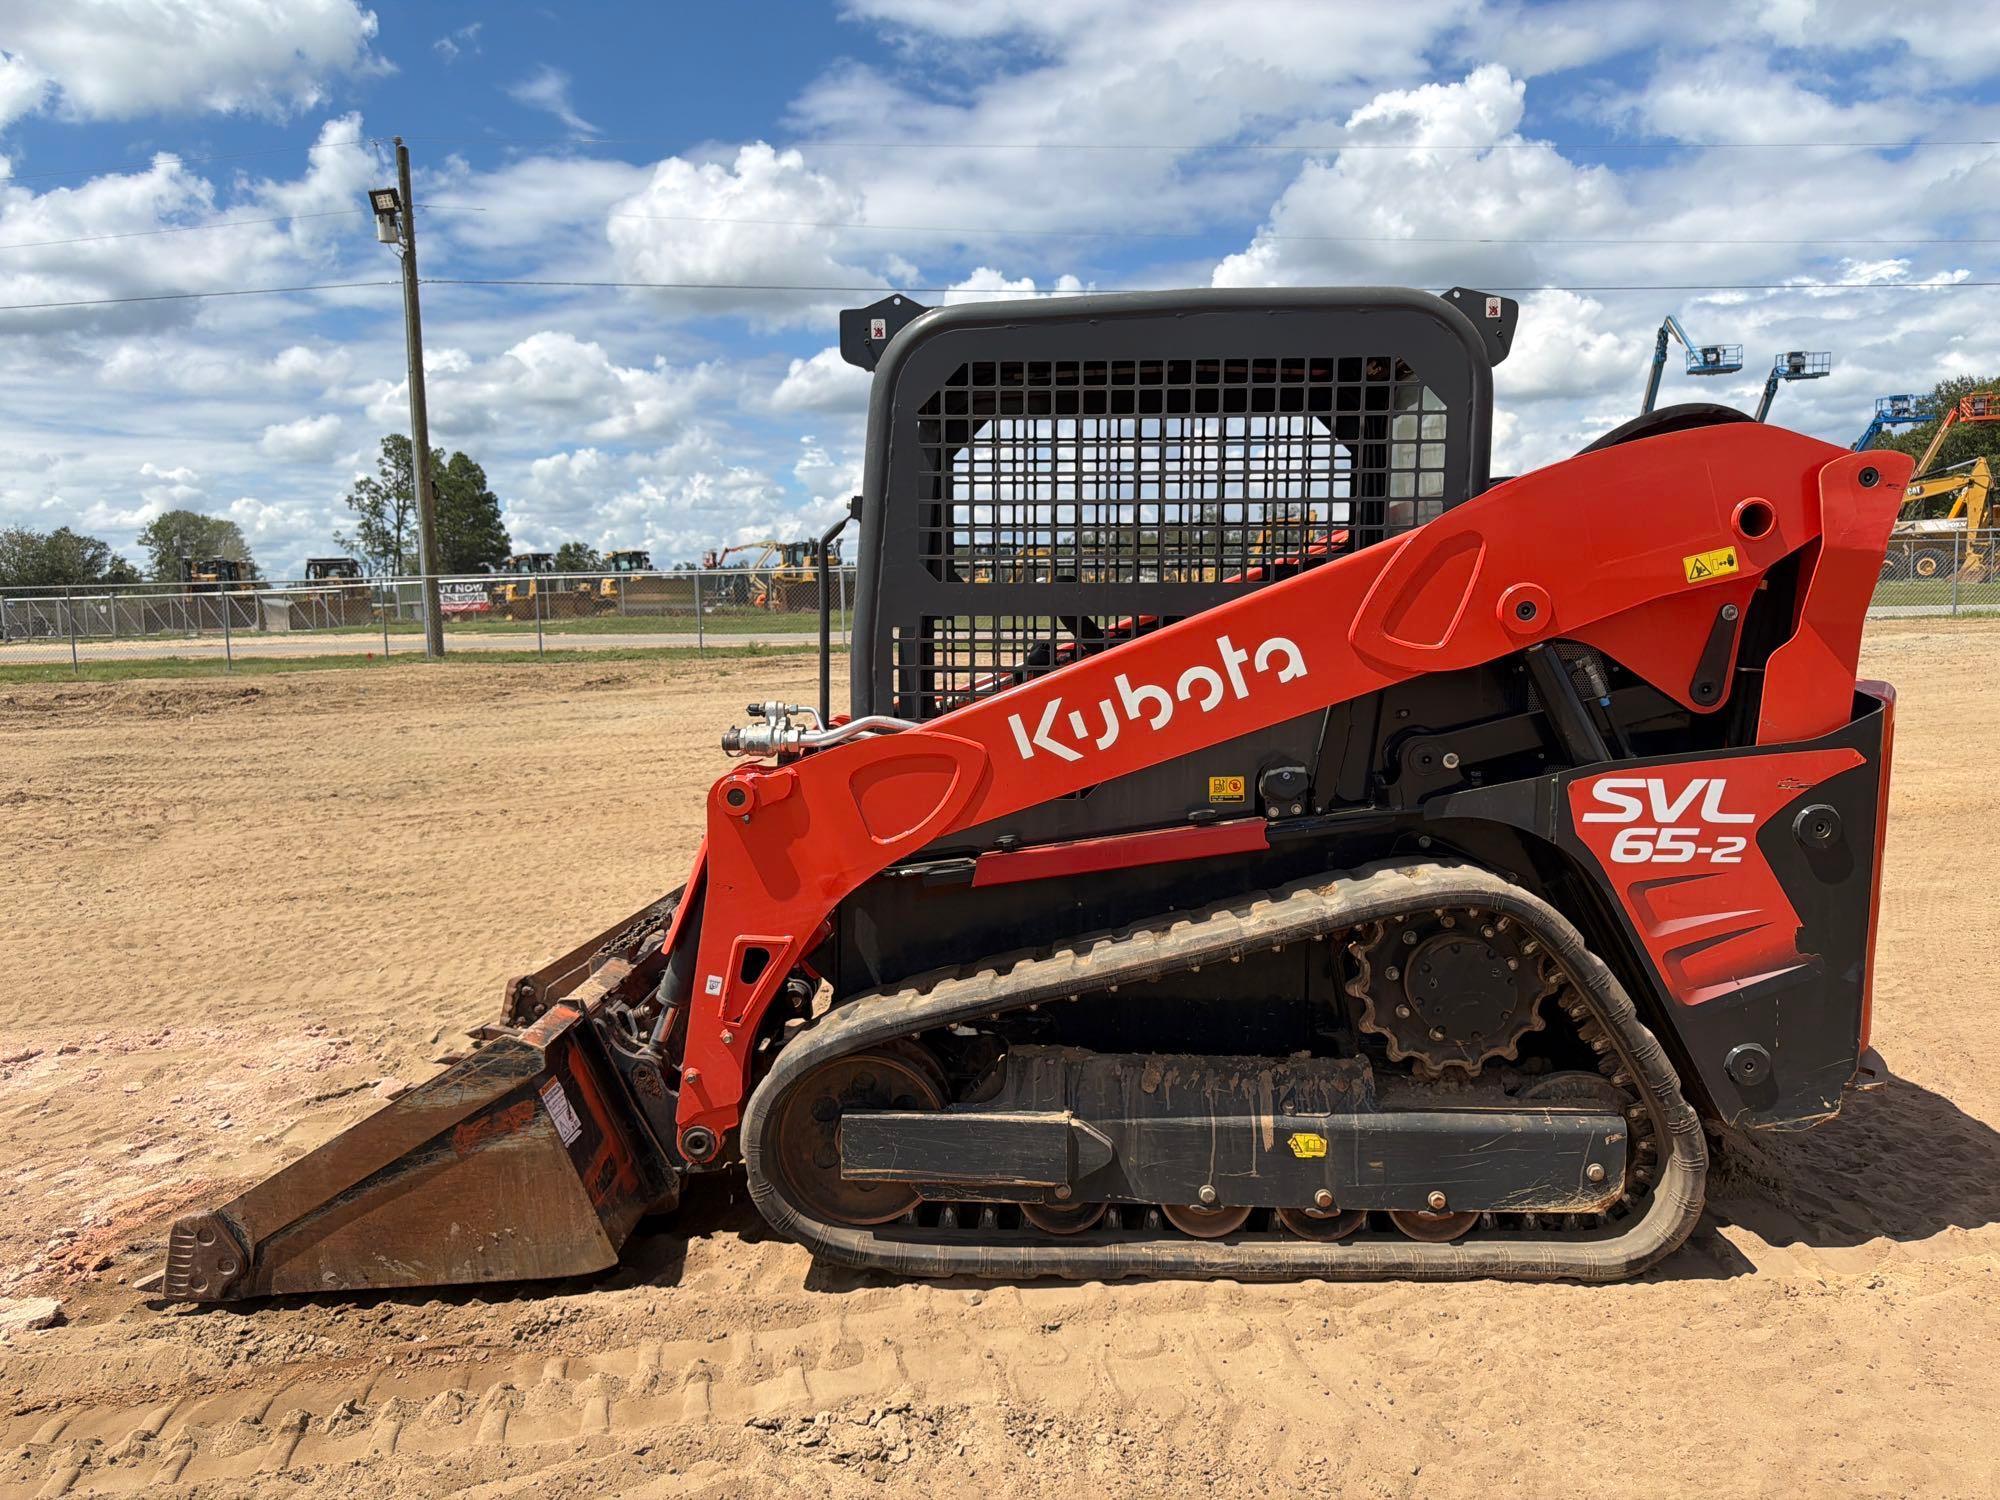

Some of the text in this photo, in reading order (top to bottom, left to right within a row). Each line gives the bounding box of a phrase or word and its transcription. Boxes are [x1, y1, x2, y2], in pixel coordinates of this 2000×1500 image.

[1906, 486, 1921, 496] CAT
[438, 583, 483, 594] UY NOW
[1007, 634, 1308, 762] Kubota
[1582, 778, 1756, 824] SVL
[1610, 827, 1747, 864] 65-2
